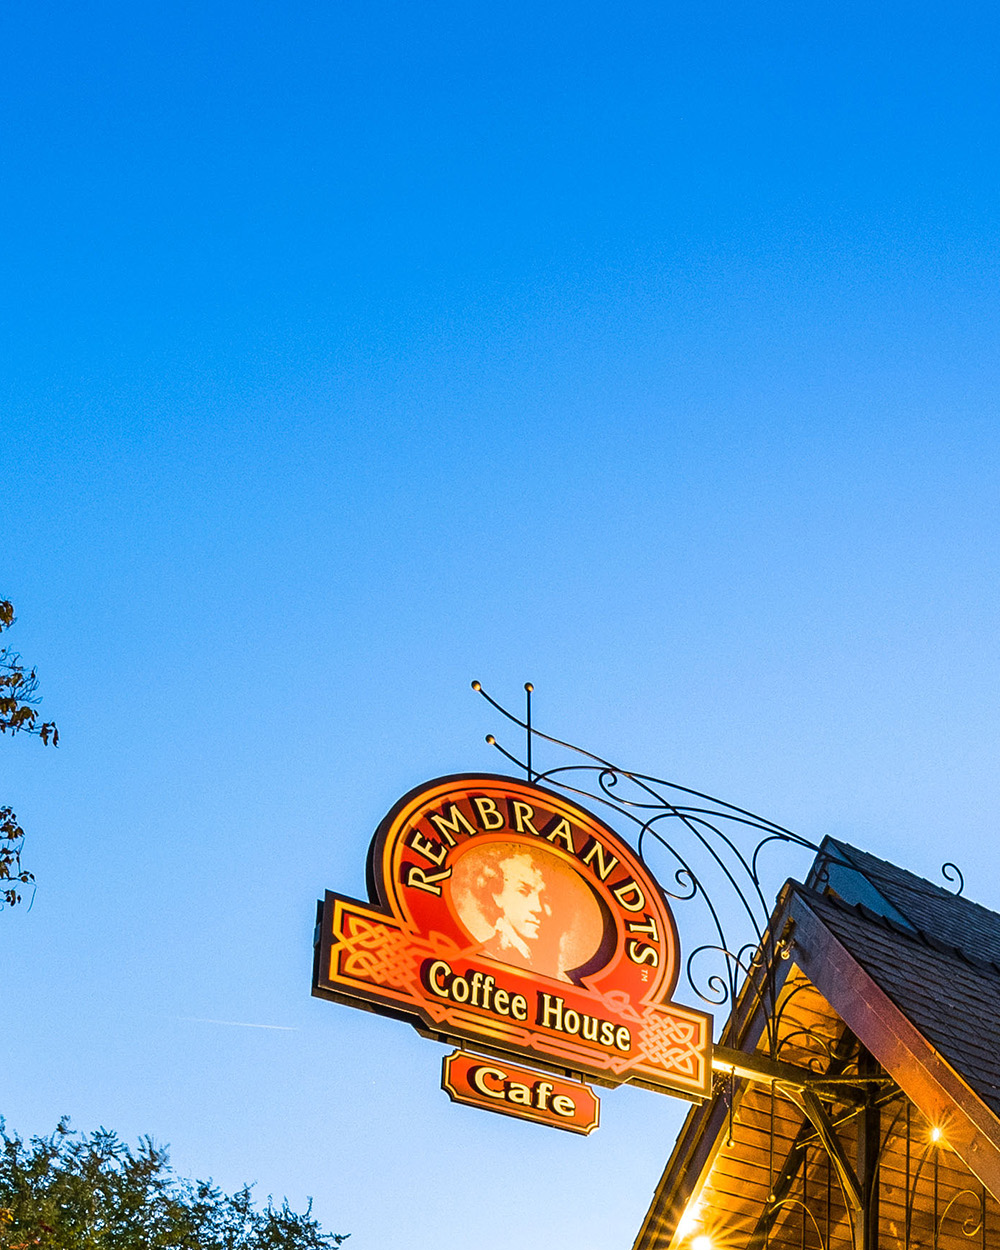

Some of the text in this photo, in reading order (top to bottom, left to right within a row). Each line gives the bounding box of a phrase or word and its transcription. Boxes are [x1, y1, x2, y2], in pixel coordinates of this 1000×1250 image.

[406, 796, 660, 968] REMBRANDTS
[428, 959, 632, 1053] Coffee House
[473, 1066, 577, 1117] Cafe
